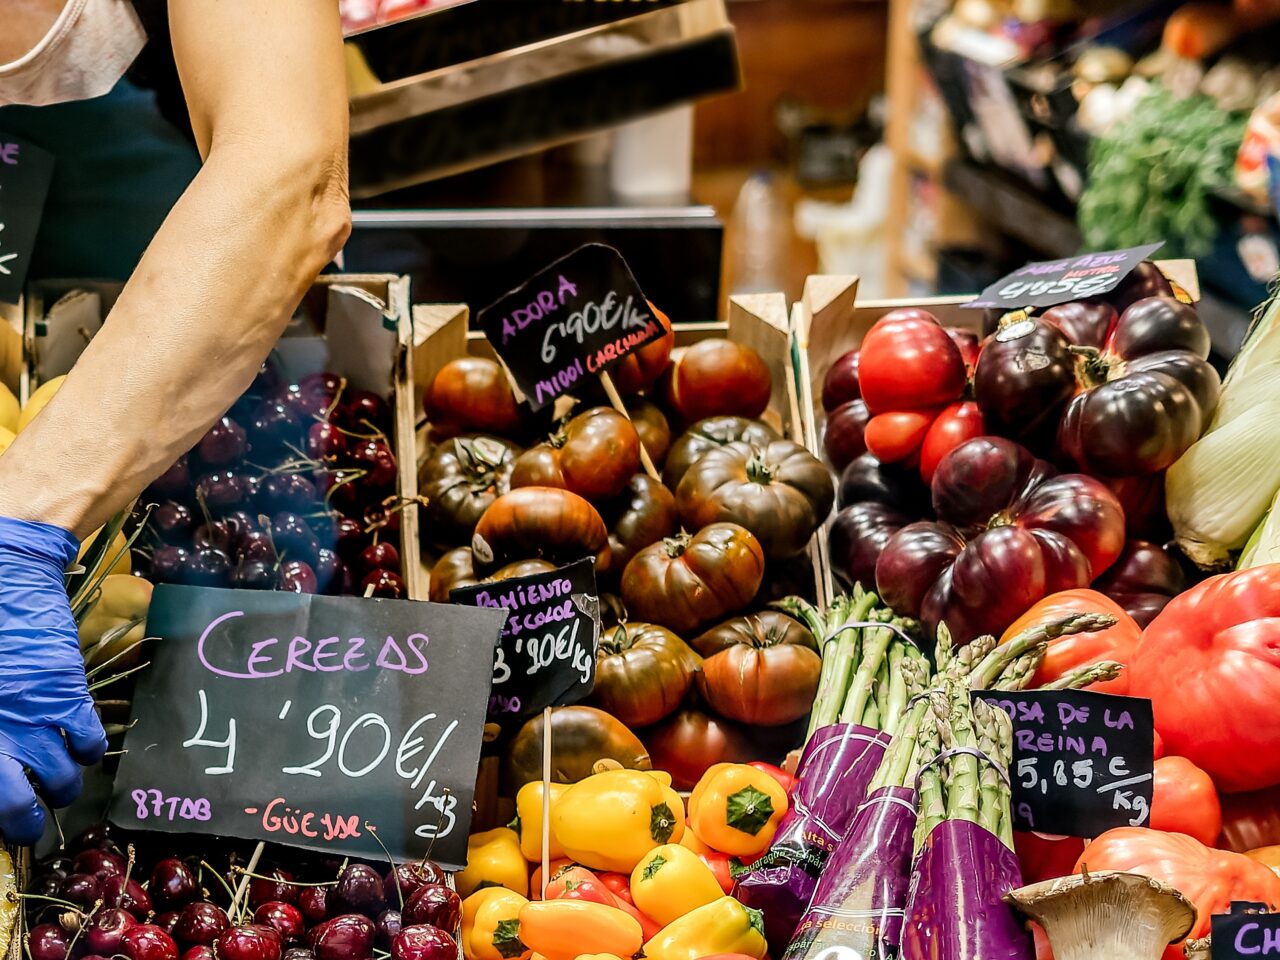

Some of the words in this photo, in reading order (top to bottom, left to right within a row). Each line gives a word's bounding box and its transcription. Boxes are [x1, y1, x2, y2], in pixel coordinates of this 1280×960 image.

[501, 274, 578, 345] ADORA
[196, 610, 431, 680] CEREZAS
[983, 697, 1045, 725] OSA
[1103, 708, 1134, 730] LA
[1015, 729, 1108, 757] REINA
